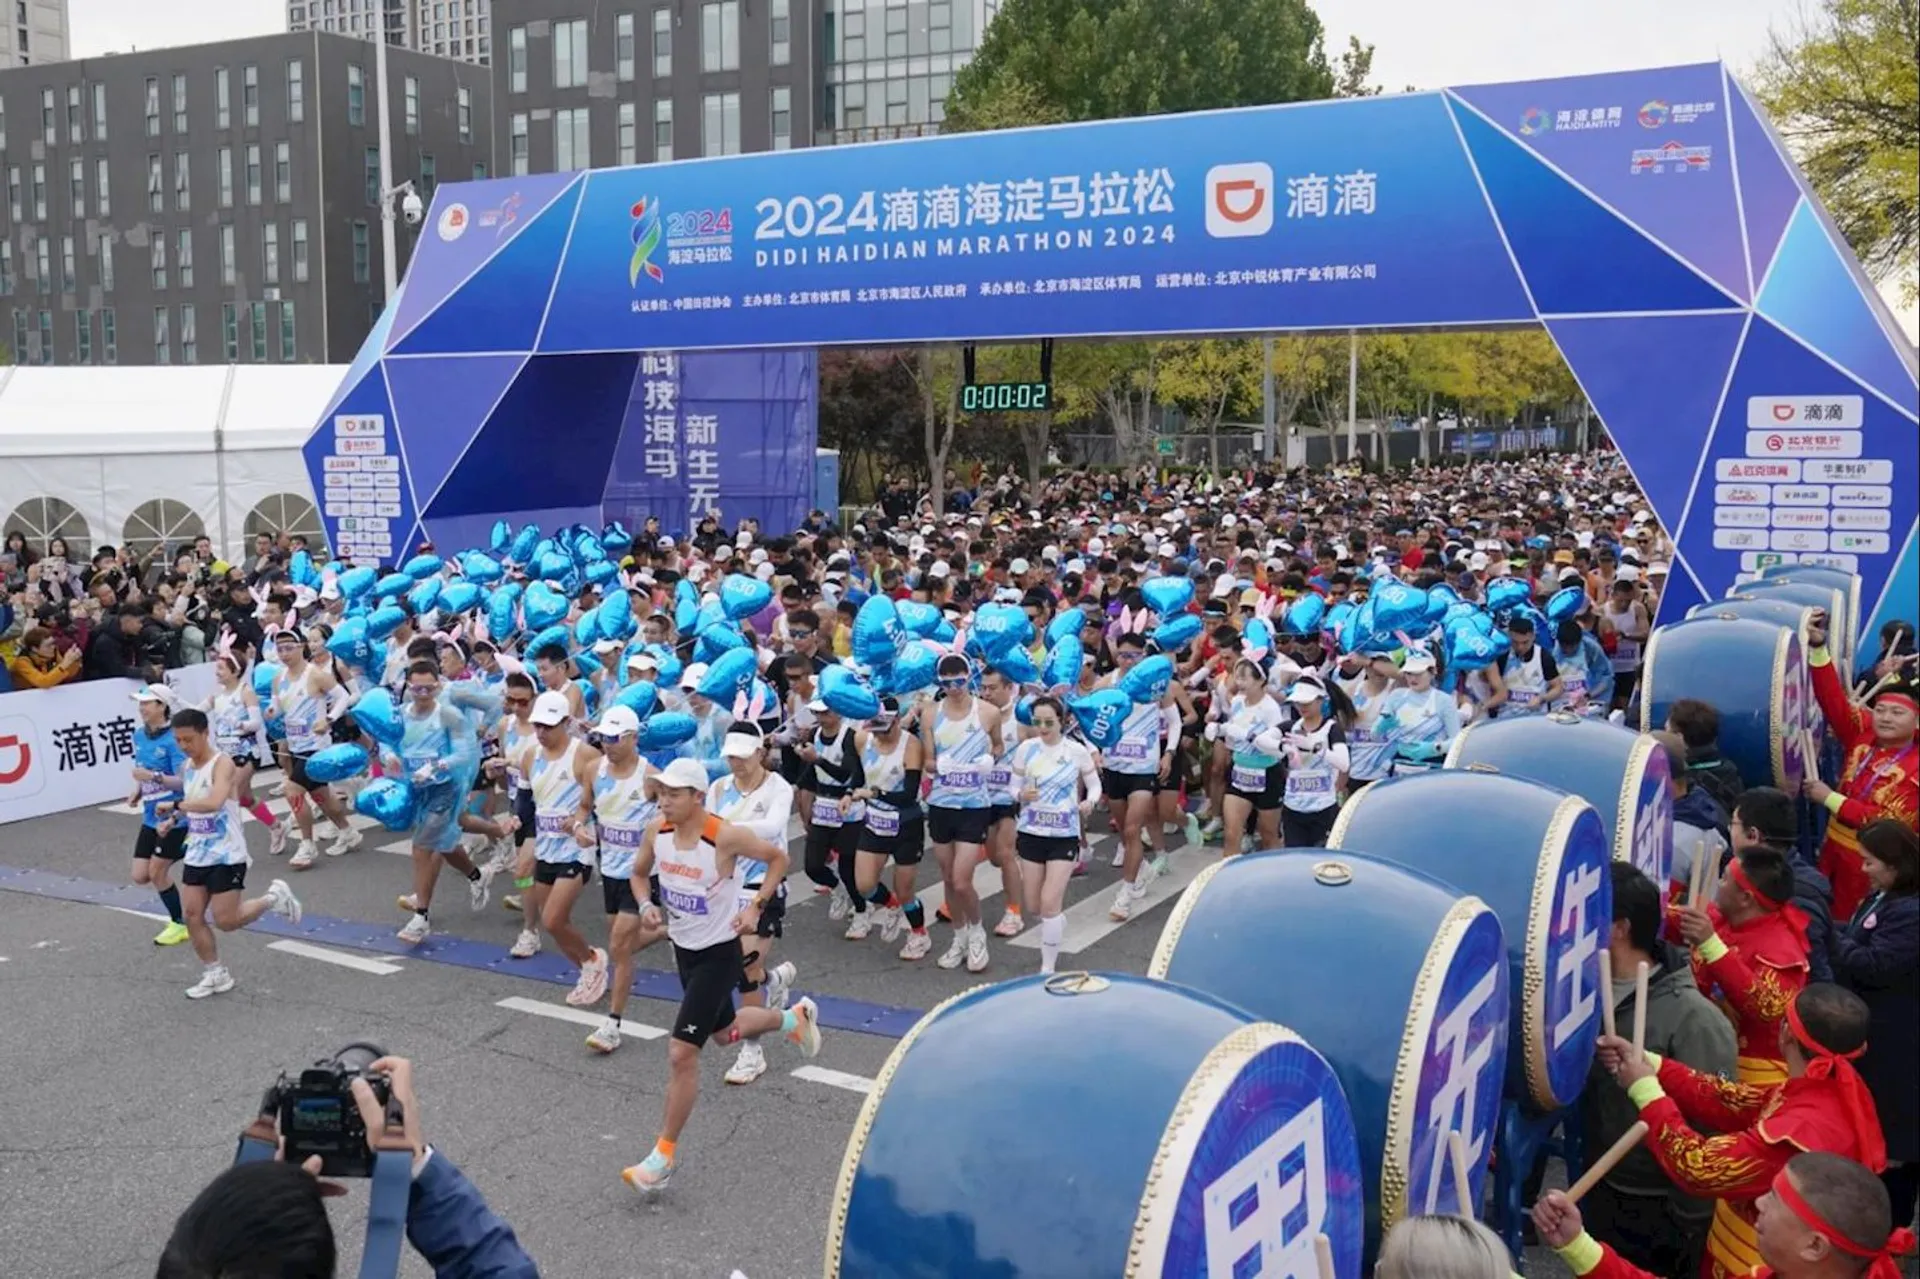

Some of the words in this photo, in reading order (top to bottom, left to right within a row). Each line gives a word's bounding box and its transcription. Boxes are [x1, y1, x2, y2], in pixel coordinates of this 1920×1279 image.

[755, 168, 1175, 240] 2024滴滴海淀马拉松
[1286, 169, 1377, 218] 滴滴
[667, 208, 732, 238] 2024
[668, 245, 732, 265] 海淀马拉松
[756, 249, 808, 267] DIDI
[818, 240, 927, 263] HAIDIAN
[937, 229, 1093, 257] MARATHON
[1104, 225, 1175, 247] 2024
[964, 384, 1047, 409] 0:00:02
[1804, 403, 1844, 421] 滴滴
[1089, 703, 1117, 741] 5:00
[52, 715, 136, 772] 滴滴
